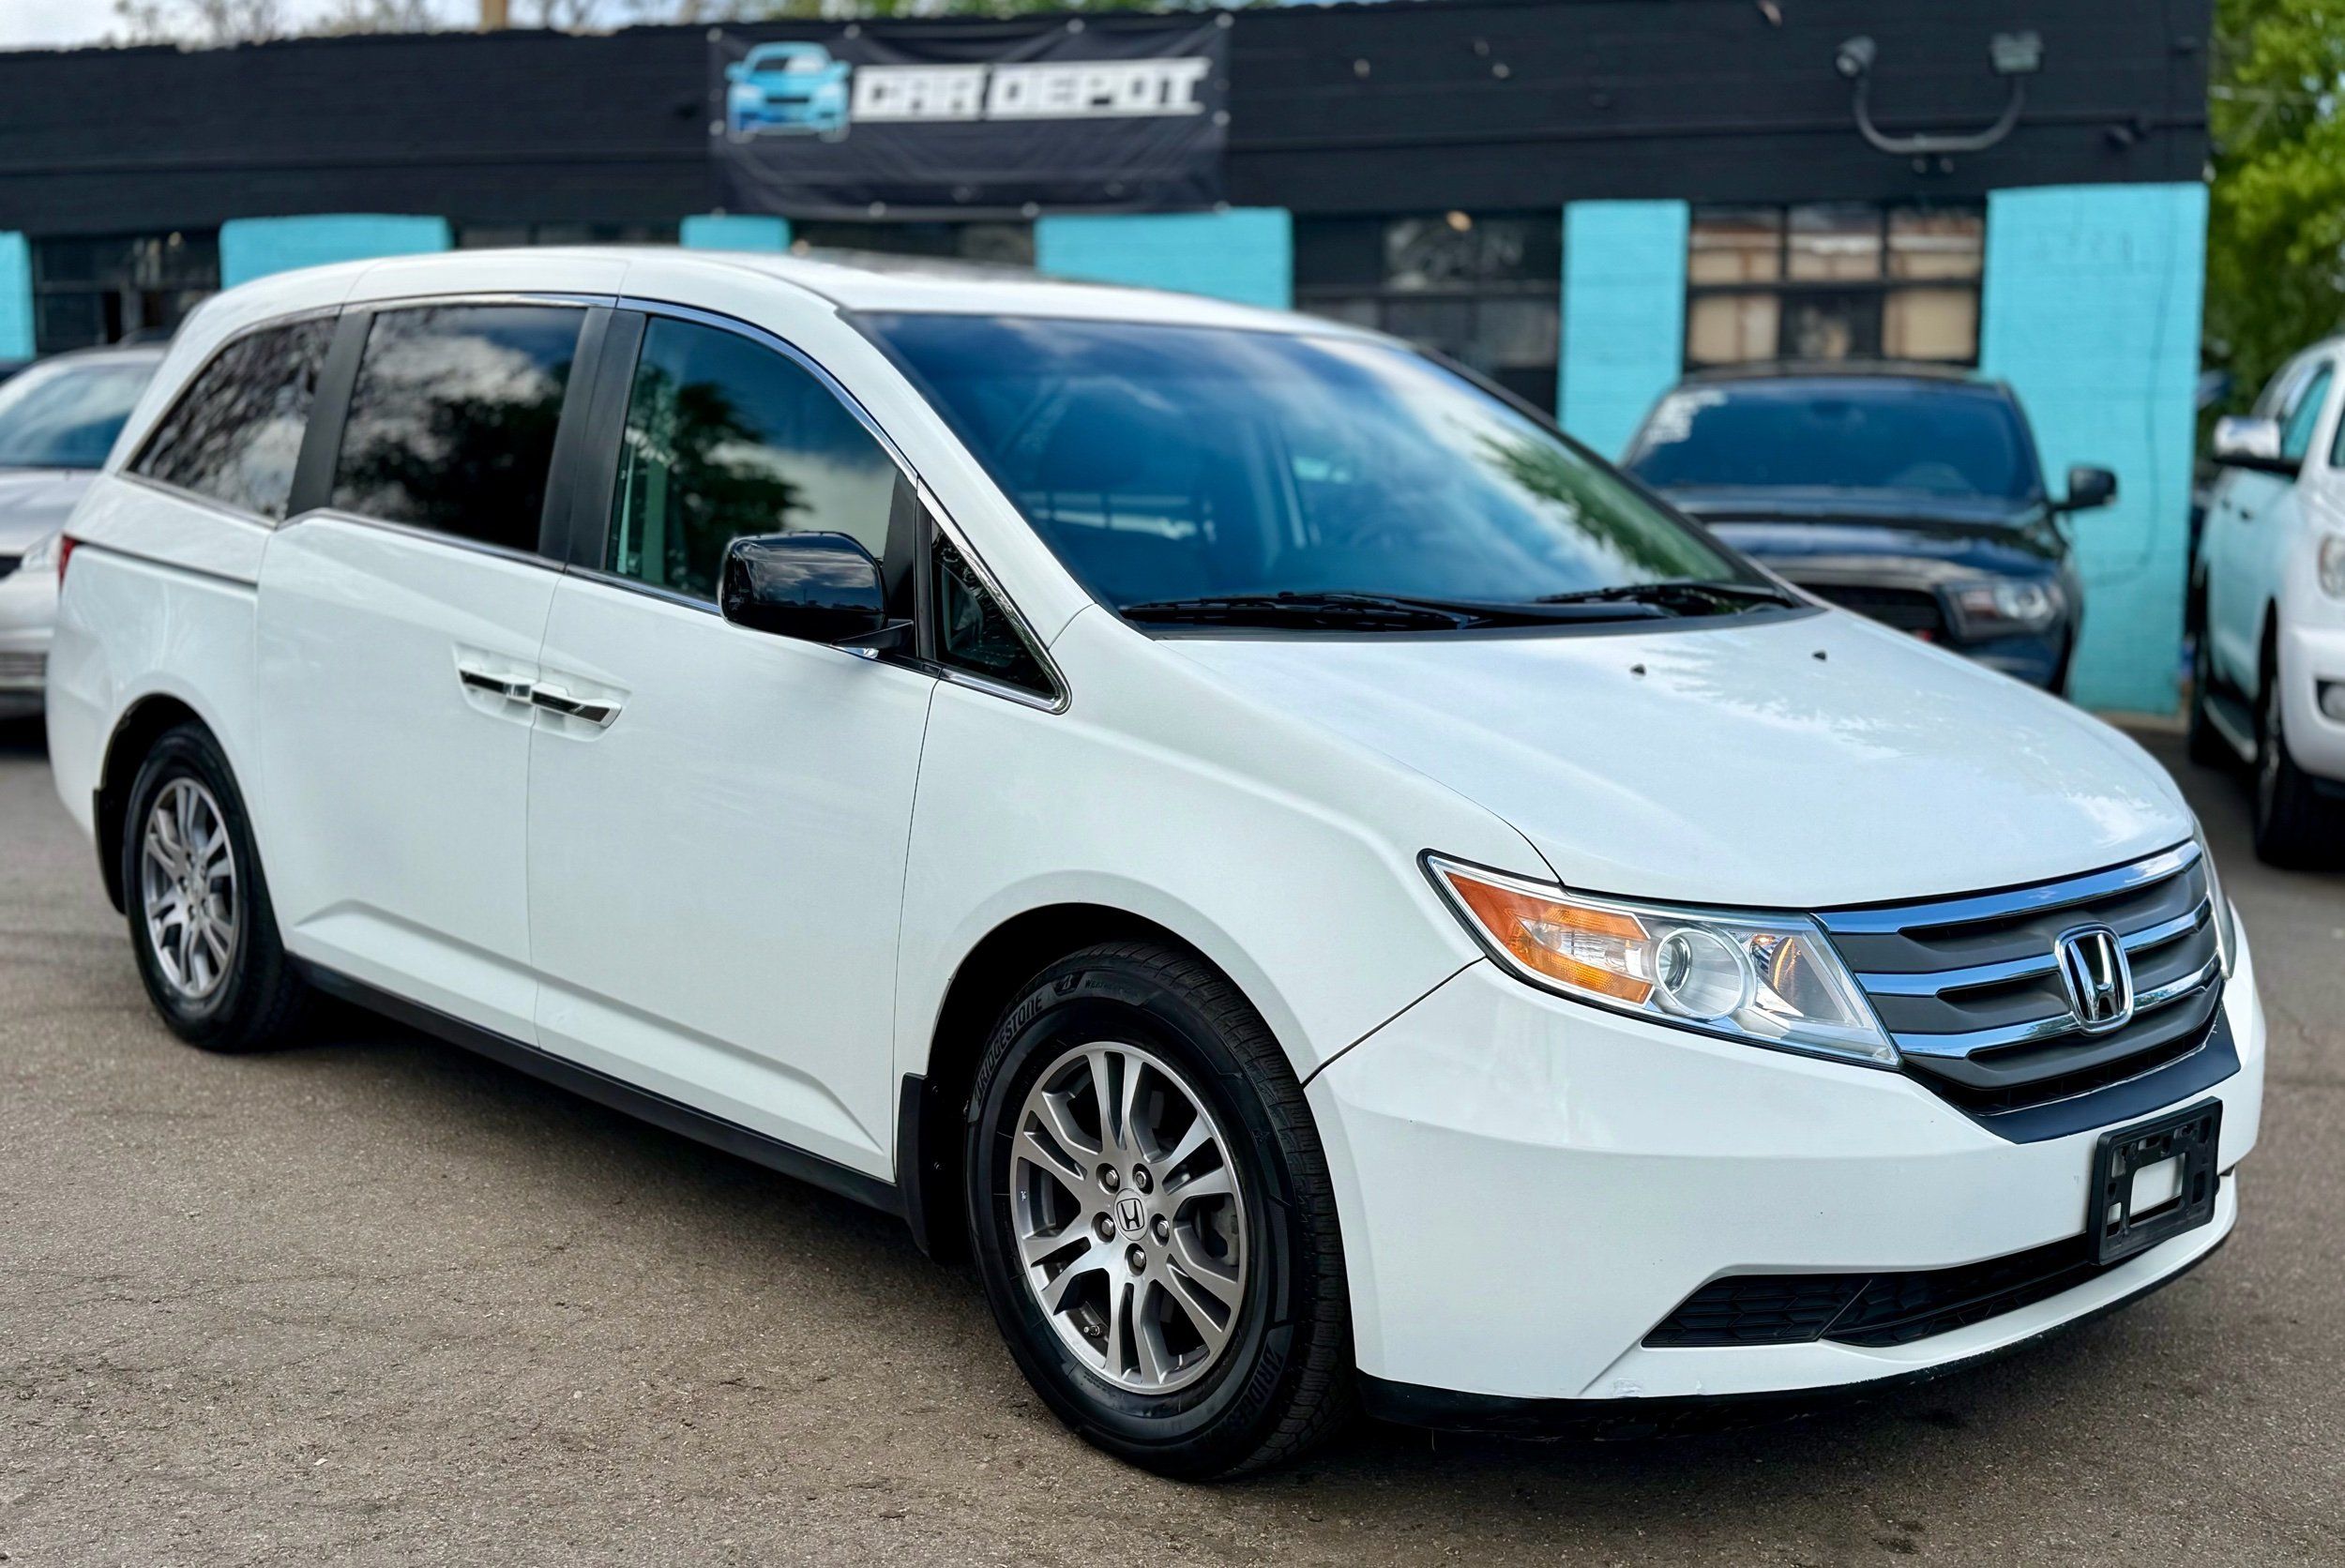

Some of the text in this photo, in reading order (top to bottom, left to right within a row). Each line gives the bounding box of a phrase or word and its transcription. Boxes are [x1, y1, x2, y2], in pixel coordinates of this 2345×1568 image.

[851, 56, 1213, 123] CAR DEPOT
[974, 992, 1044, 1108] BRIDGESTONE
